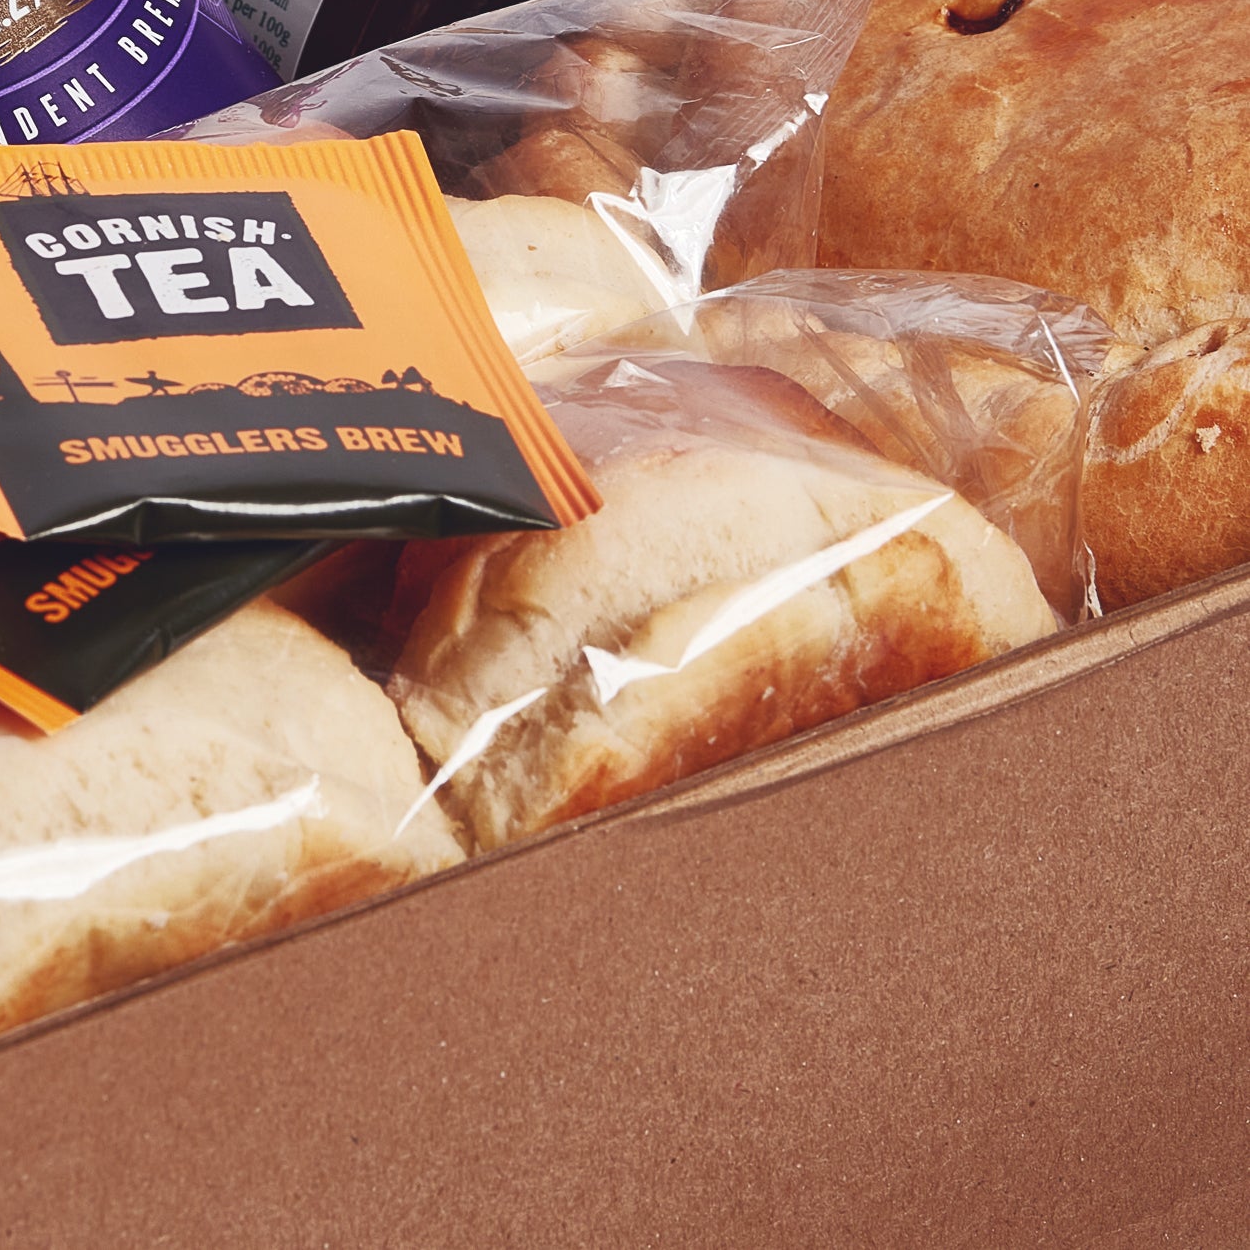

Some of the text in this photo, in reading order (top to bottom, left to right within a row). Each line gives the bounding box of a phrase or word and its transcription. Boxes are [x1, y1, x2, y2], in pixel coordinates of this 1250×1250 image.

[258, 12, 291, 48] 100g
[54, 246, 315, 320] TEA
[59, 426, 465, 465] SMUGGLERS BREW
